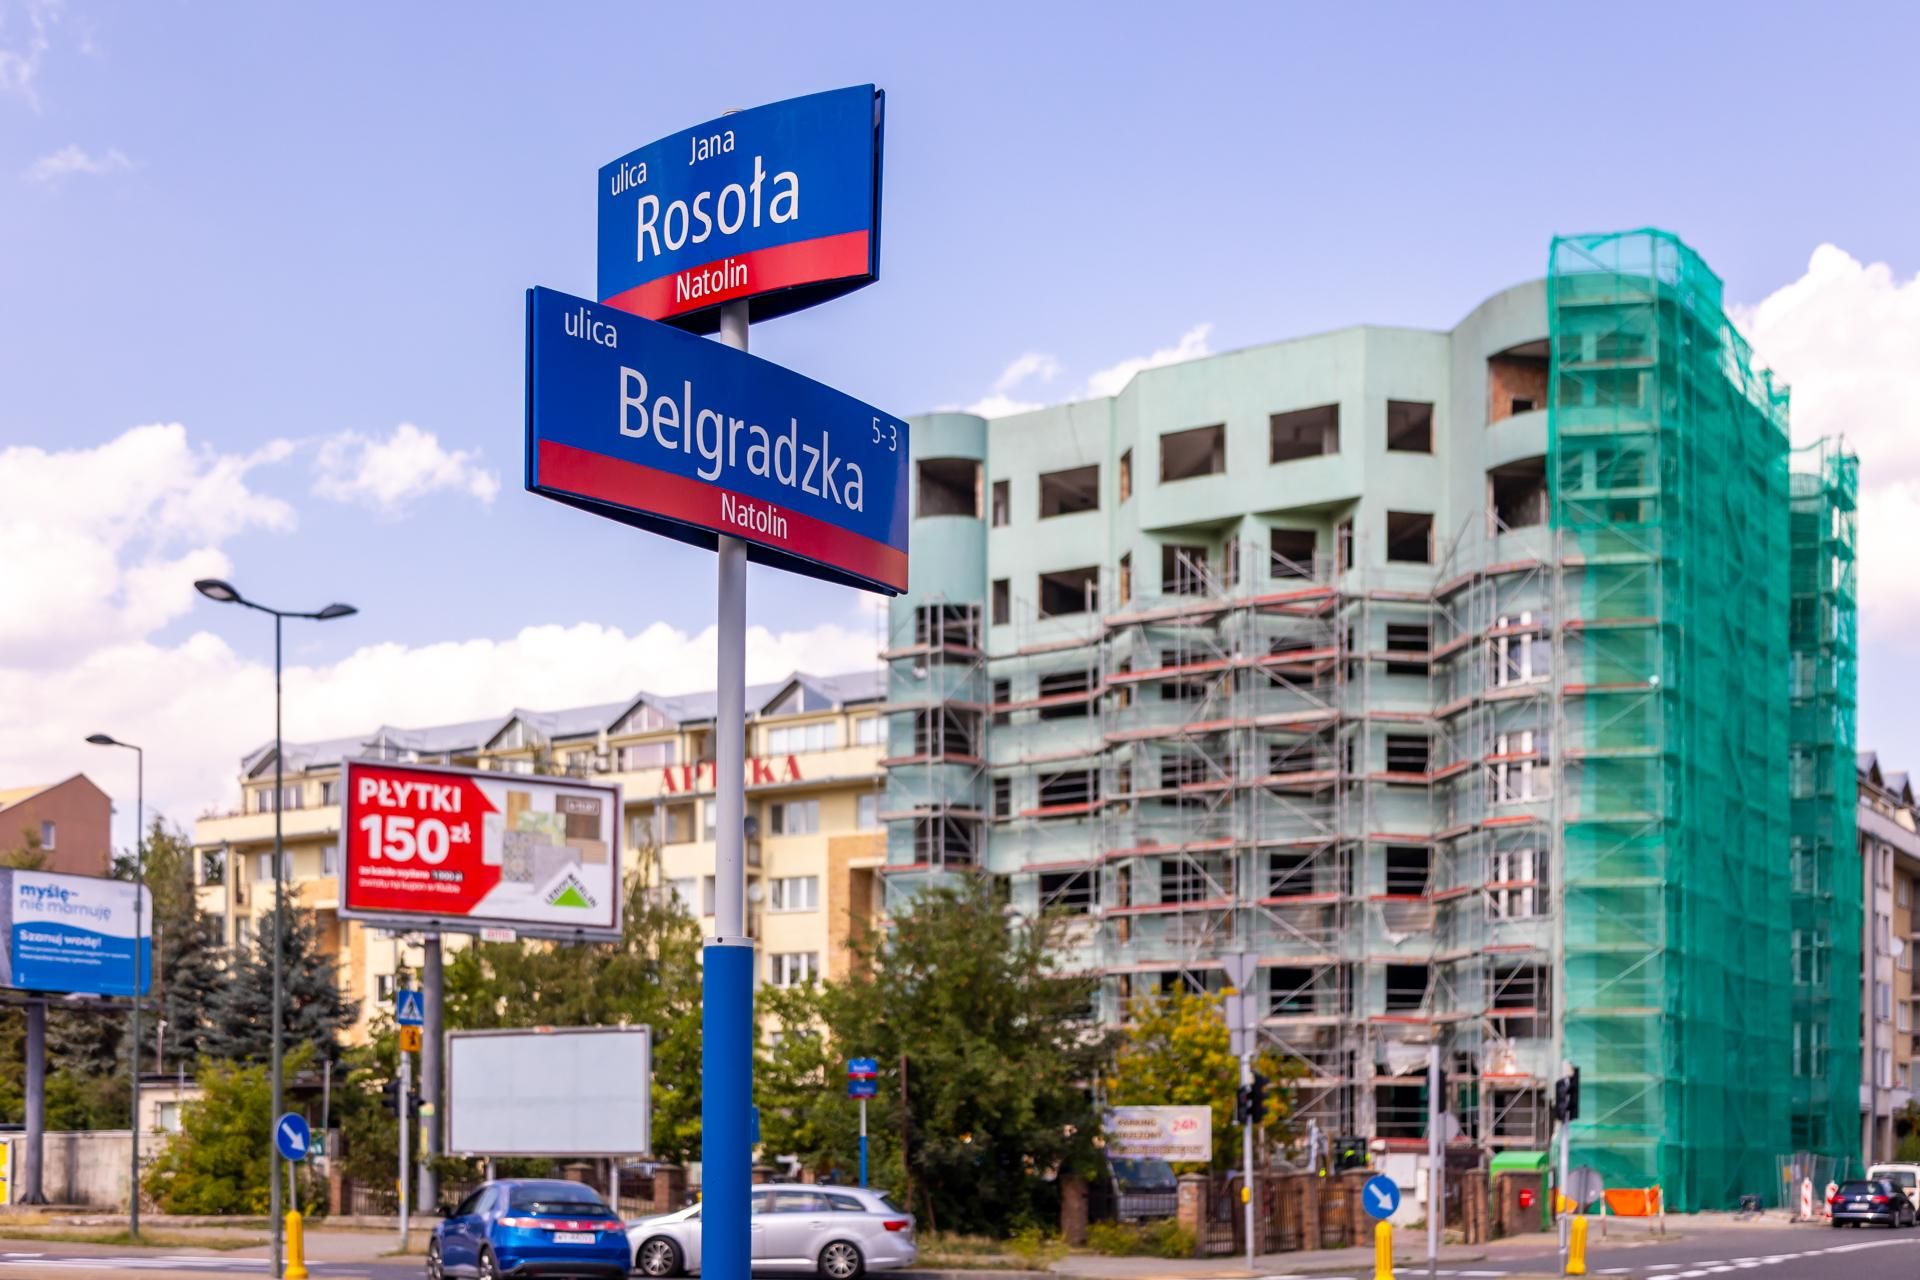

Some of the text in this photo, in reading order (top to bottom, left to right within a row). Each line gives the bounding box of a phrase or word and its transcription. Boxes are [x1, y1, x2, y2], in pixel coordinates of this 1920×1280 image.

[689, 130, 735, 166] Jana
[611, 161, 647, 196] ulica
[636, 155, 799, 262] Rosoła
[676, 259, 748, 303] Natolin
[564, 306, 618, 349] ulica
[619, 365, 864, 513] Belgradzka
[872, 417, 898, 452] 5-3
[721, 493, 788, 540] Natolin
[659, 753, 804, 793] APTKA
[359, 777, 461, 813] PŁYTKI
[20, 898, 112, 920] nie marnuję
[1171, 1118, 1199, 1132] 24h
